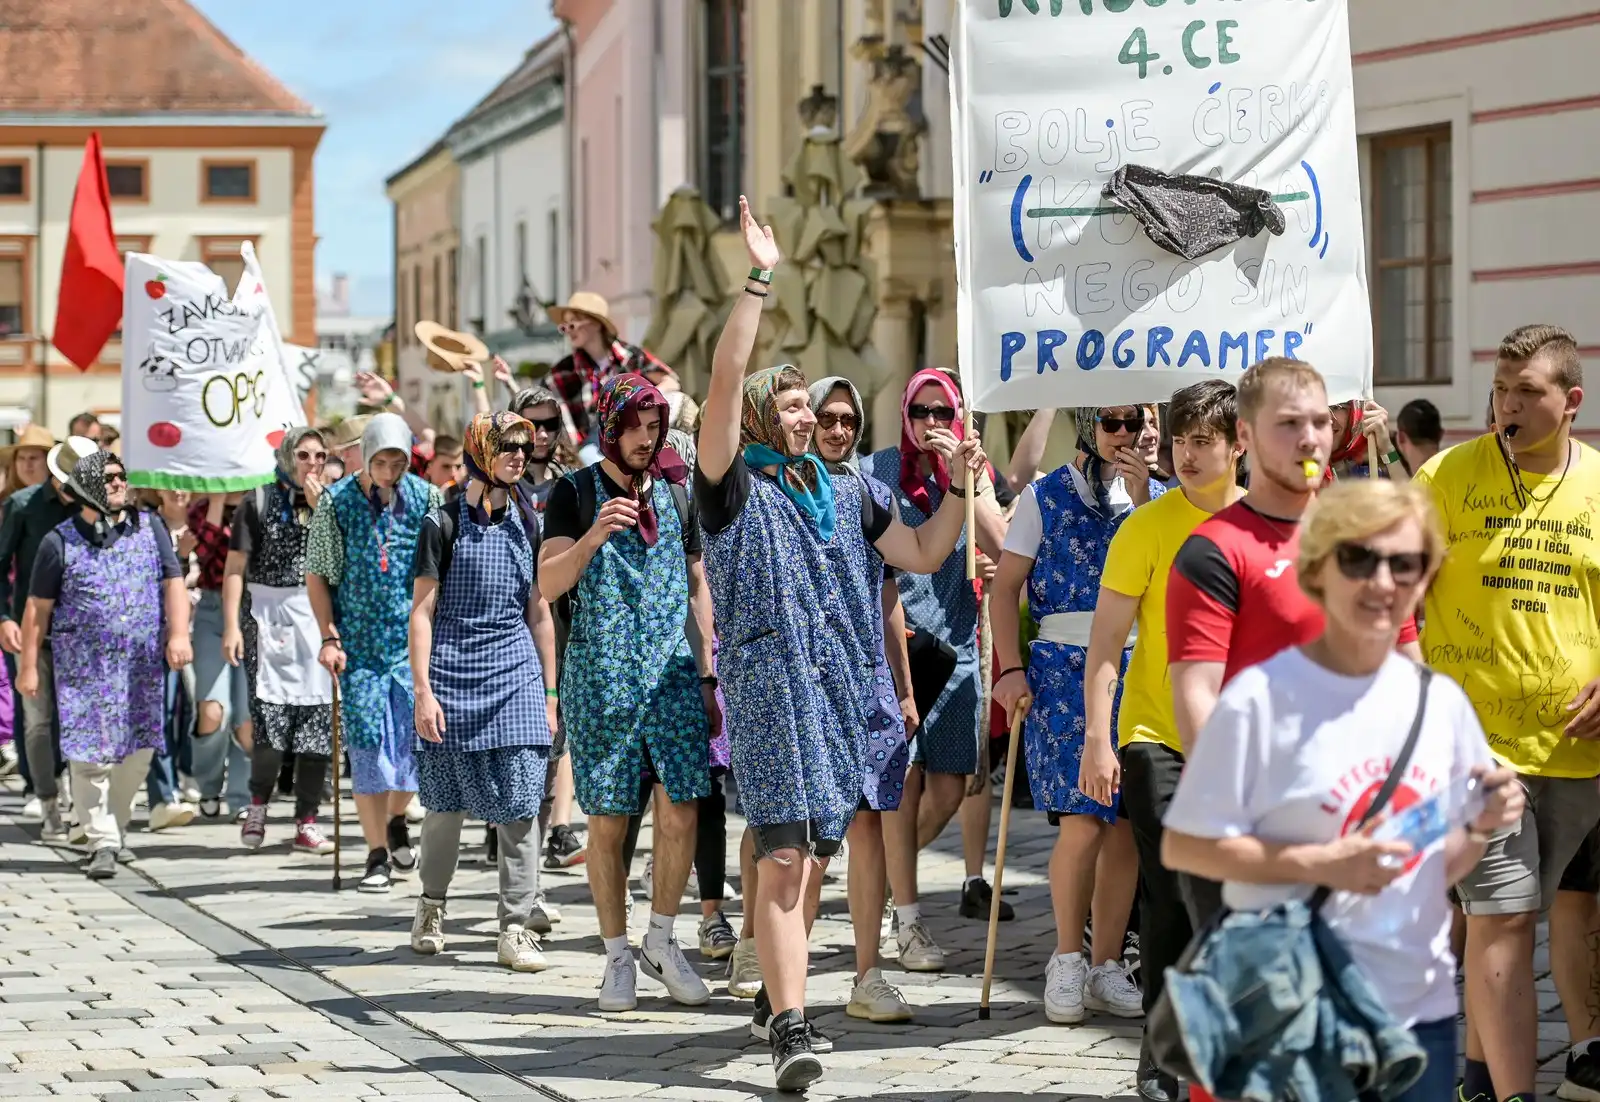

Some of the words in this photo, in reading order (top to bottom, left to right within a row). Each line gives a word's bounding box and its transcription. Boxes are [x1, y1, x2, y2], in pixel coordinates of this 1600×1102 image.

[1117, 19, 1241, 79] 4.CE
[1023, 258, 1204, 318] NEGO
[1230, 257, 1309, 318] SIN
[1484, 514, 1522, 530] Nismo
[1525, 518, 1563, 535] prelili
[1503, 536, 1533, 551] nego
[1535, 537, 1541, 551] i
[1498, 555, 1516, 570] ali
[1518, 556, 1572, 577] odlazimo
[1481, 574, 1534, 591] napokon
[1537, 581, 1551, 594] na
[1554, 583, 1580, 599] vašu
[1511, 597, 1549, 614] sreću.
